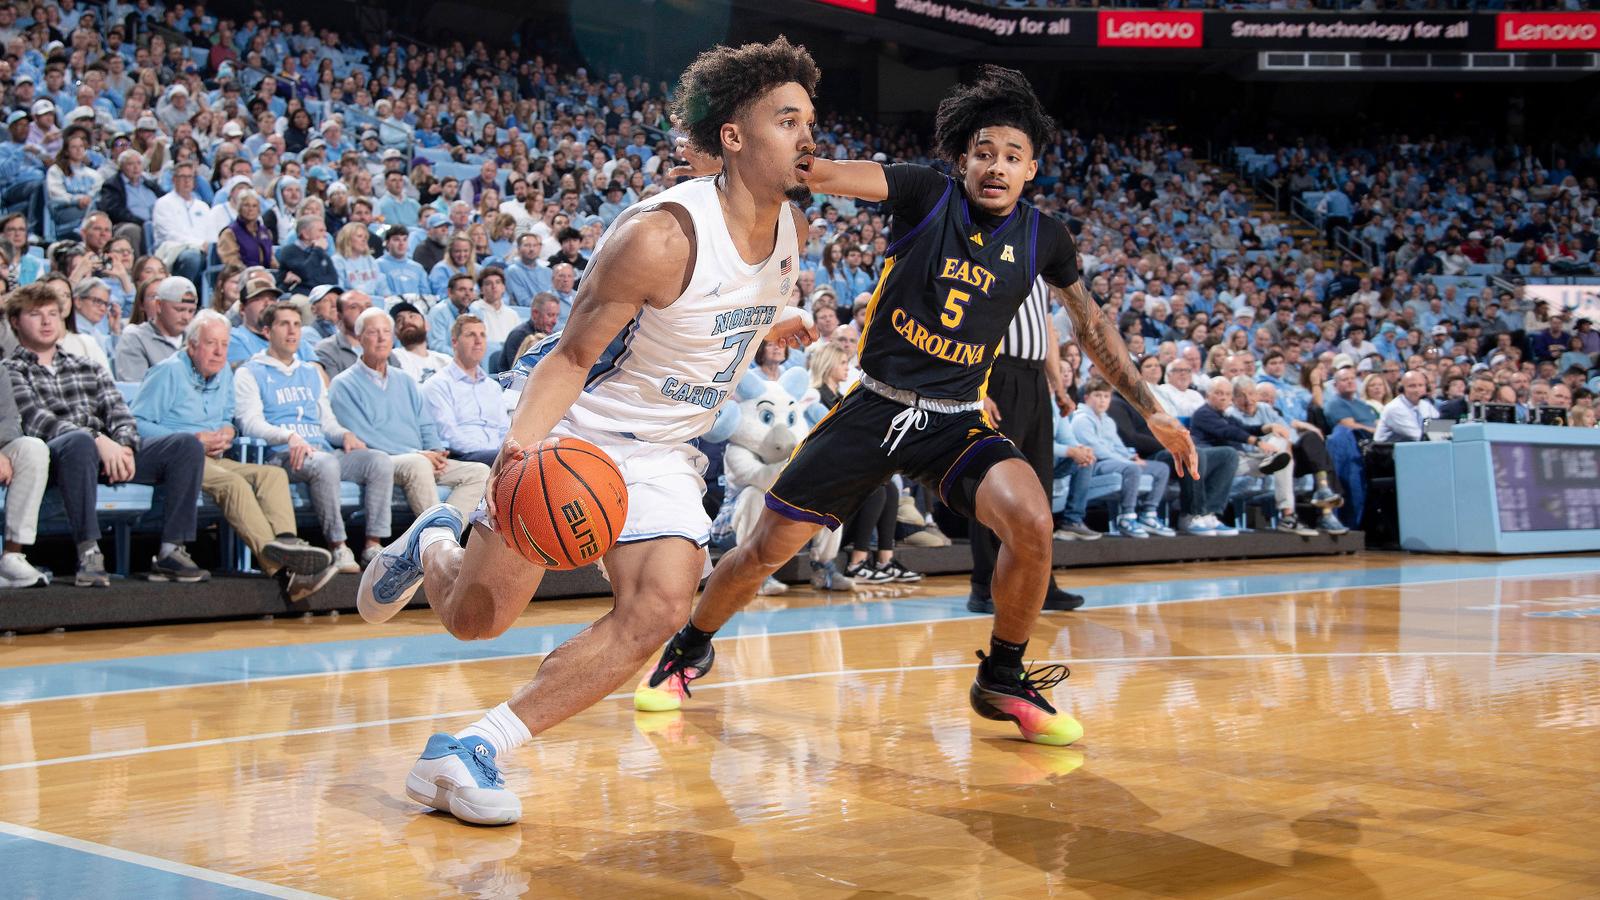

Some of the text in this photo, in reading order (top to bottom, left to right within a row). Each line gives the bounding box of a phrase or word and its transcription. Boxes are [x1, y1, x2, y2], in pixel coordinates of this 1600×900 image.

[944, 4, 1017, 36] technology
[1019, 17, 1045, 35] for
[1048, 18, 1070, 35] all
[1106, 18, 1194, 39] Lenovo
[1231, 20, 1469, 41] Smarter technology for all
[1504, 20, 1598, 41] Lenovo
[939, 257, 996, 296] EAST
[711, 305, 777, 336] NORTH
[939, 288, 971, 331] 5
[891, 307, 986, 367] CAROLINA
[712, 330, 758, 383] 7
[275, 386, 316, 406] NORTH
[561, 499, 599, 560] ELITE
